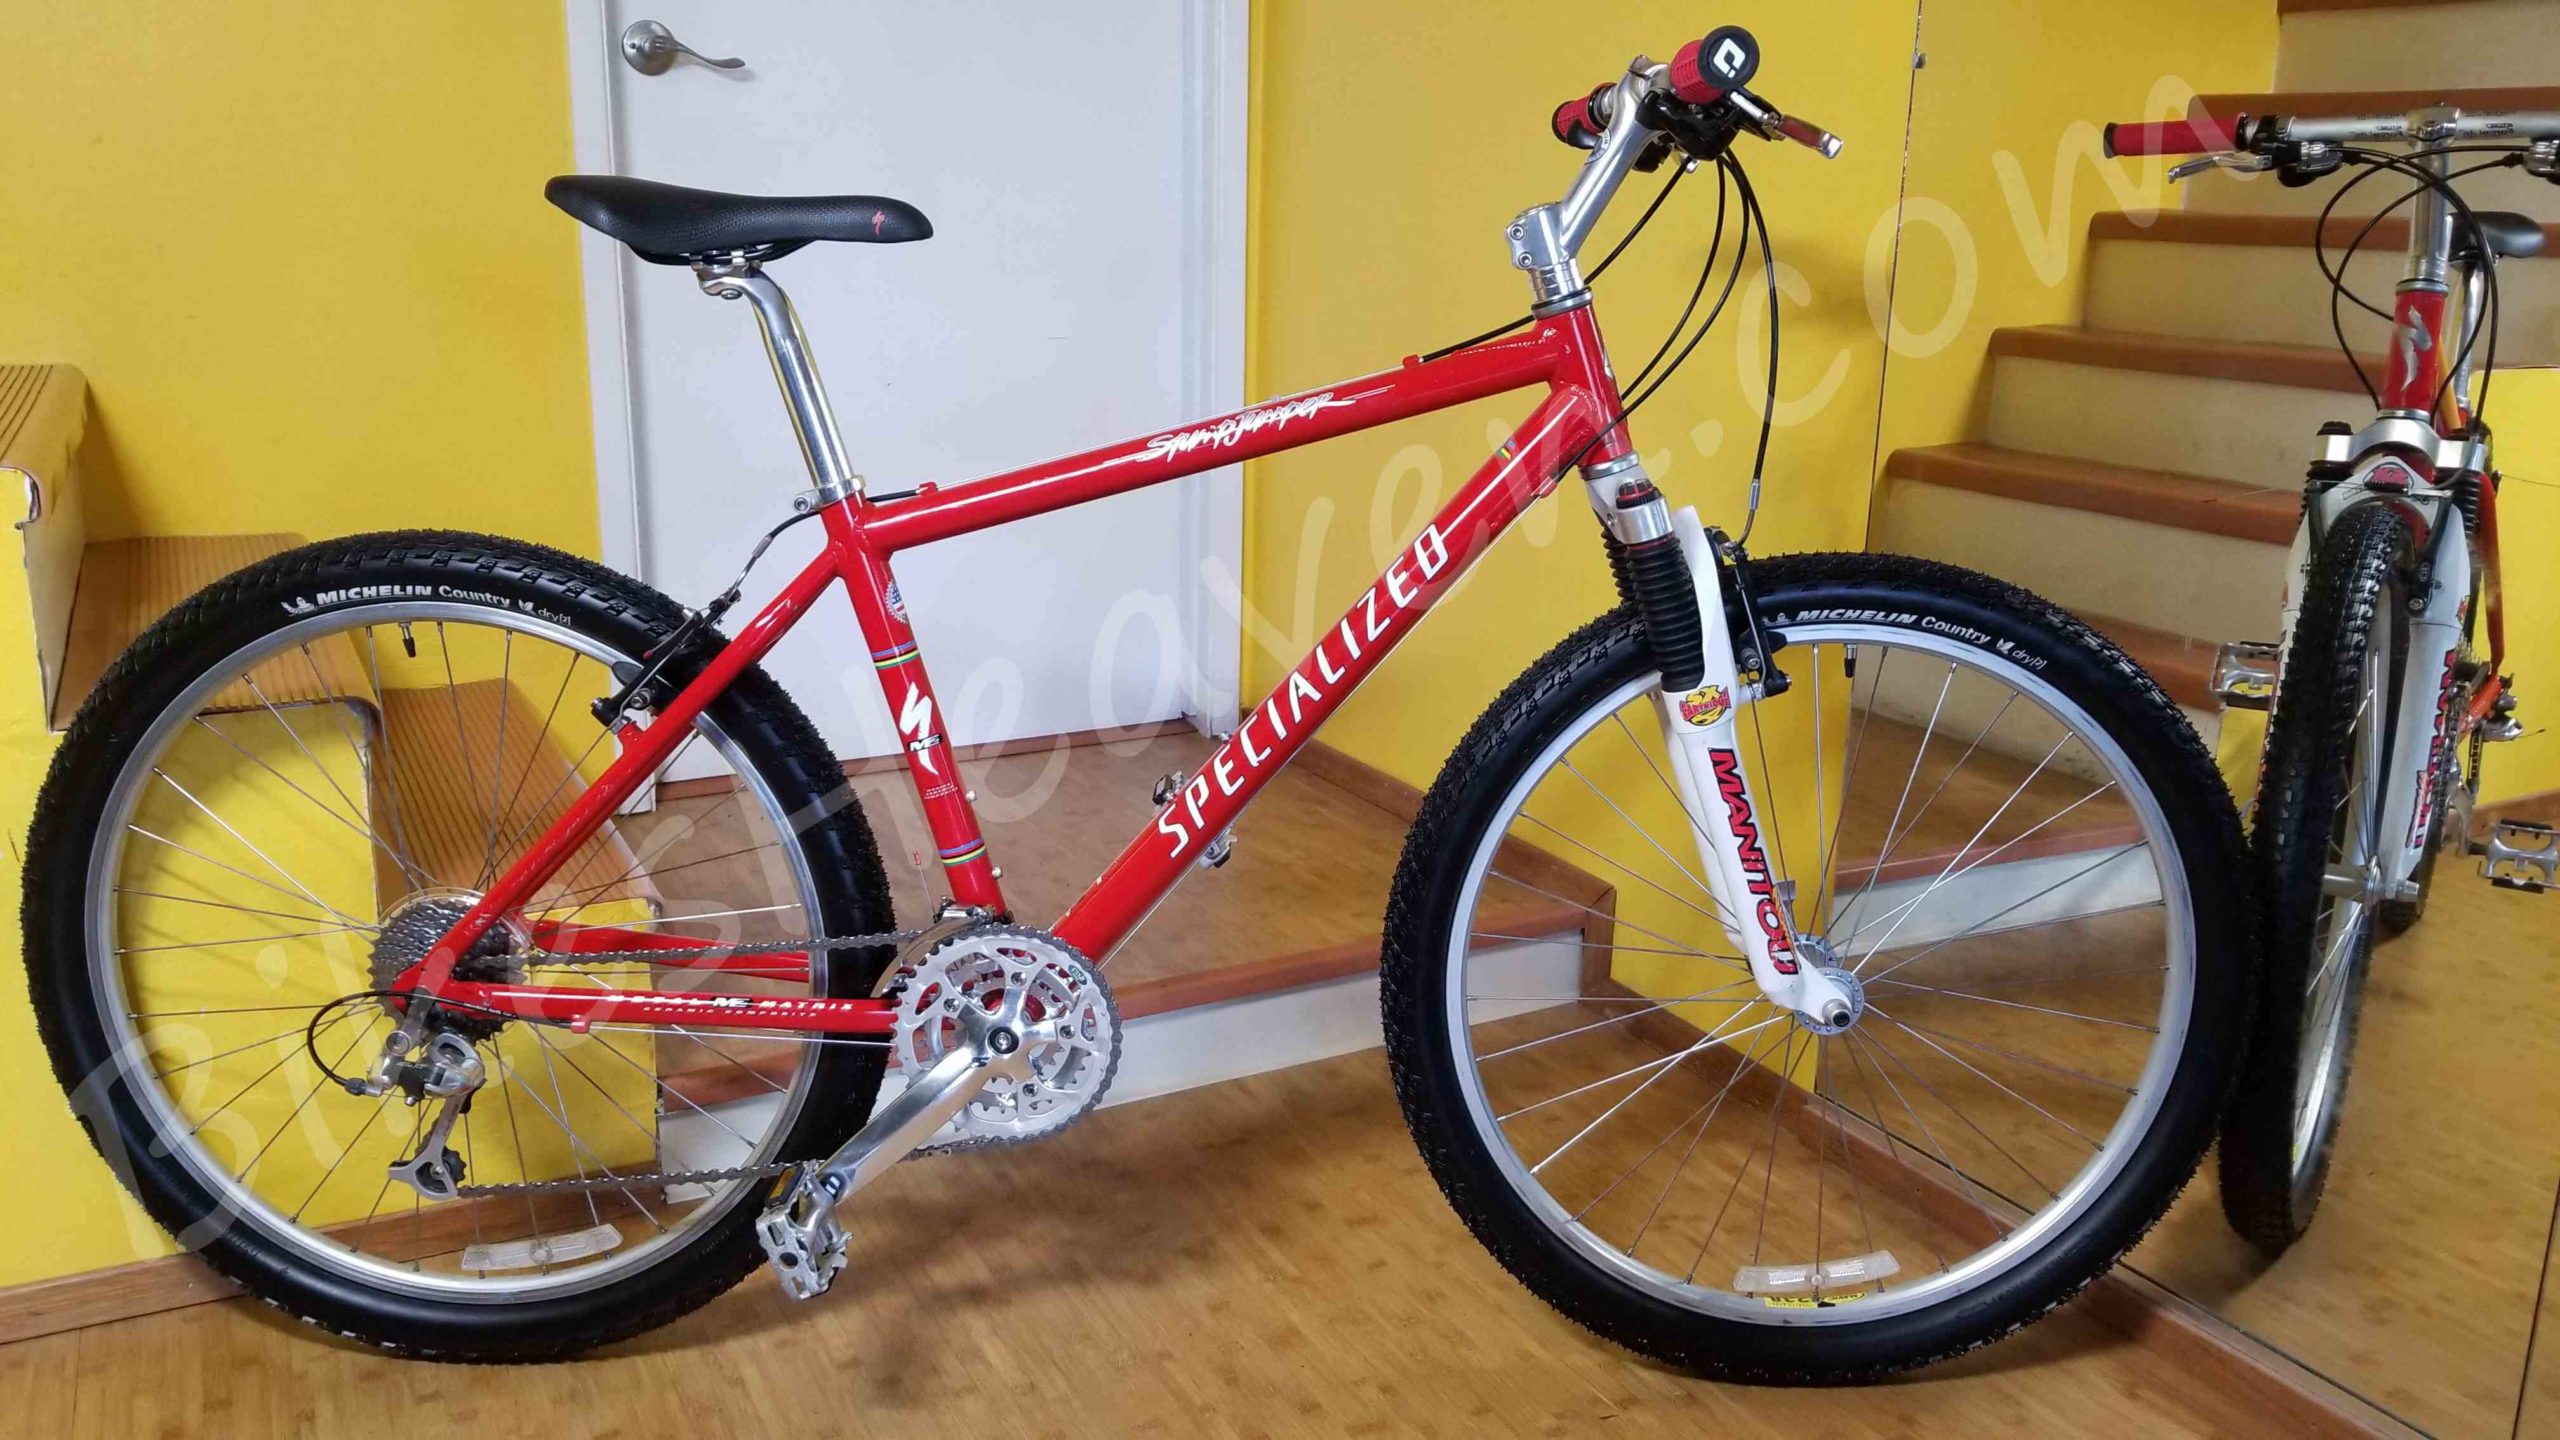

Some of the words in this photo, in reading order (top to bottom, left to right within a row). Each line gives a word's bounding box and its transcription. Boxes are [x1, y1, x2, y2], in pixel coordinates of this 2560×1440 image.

[316, 584, 432, 605] MICHELIN
[438, 584, 510, 607] Country
[1796, 608, 1918, 625] MICHELIN
[1921, 616, 1991, 644] Country
[1157, 522, 1450, 858] SPECIALIZED
[1708, 747, 1799, 975] MANITOU
[643, 1006, 714, 1014] CERAMIC
[724, 1009, 818, 1018] COMPOSITE
[758, 1000, 855, 1011] MATRIX
